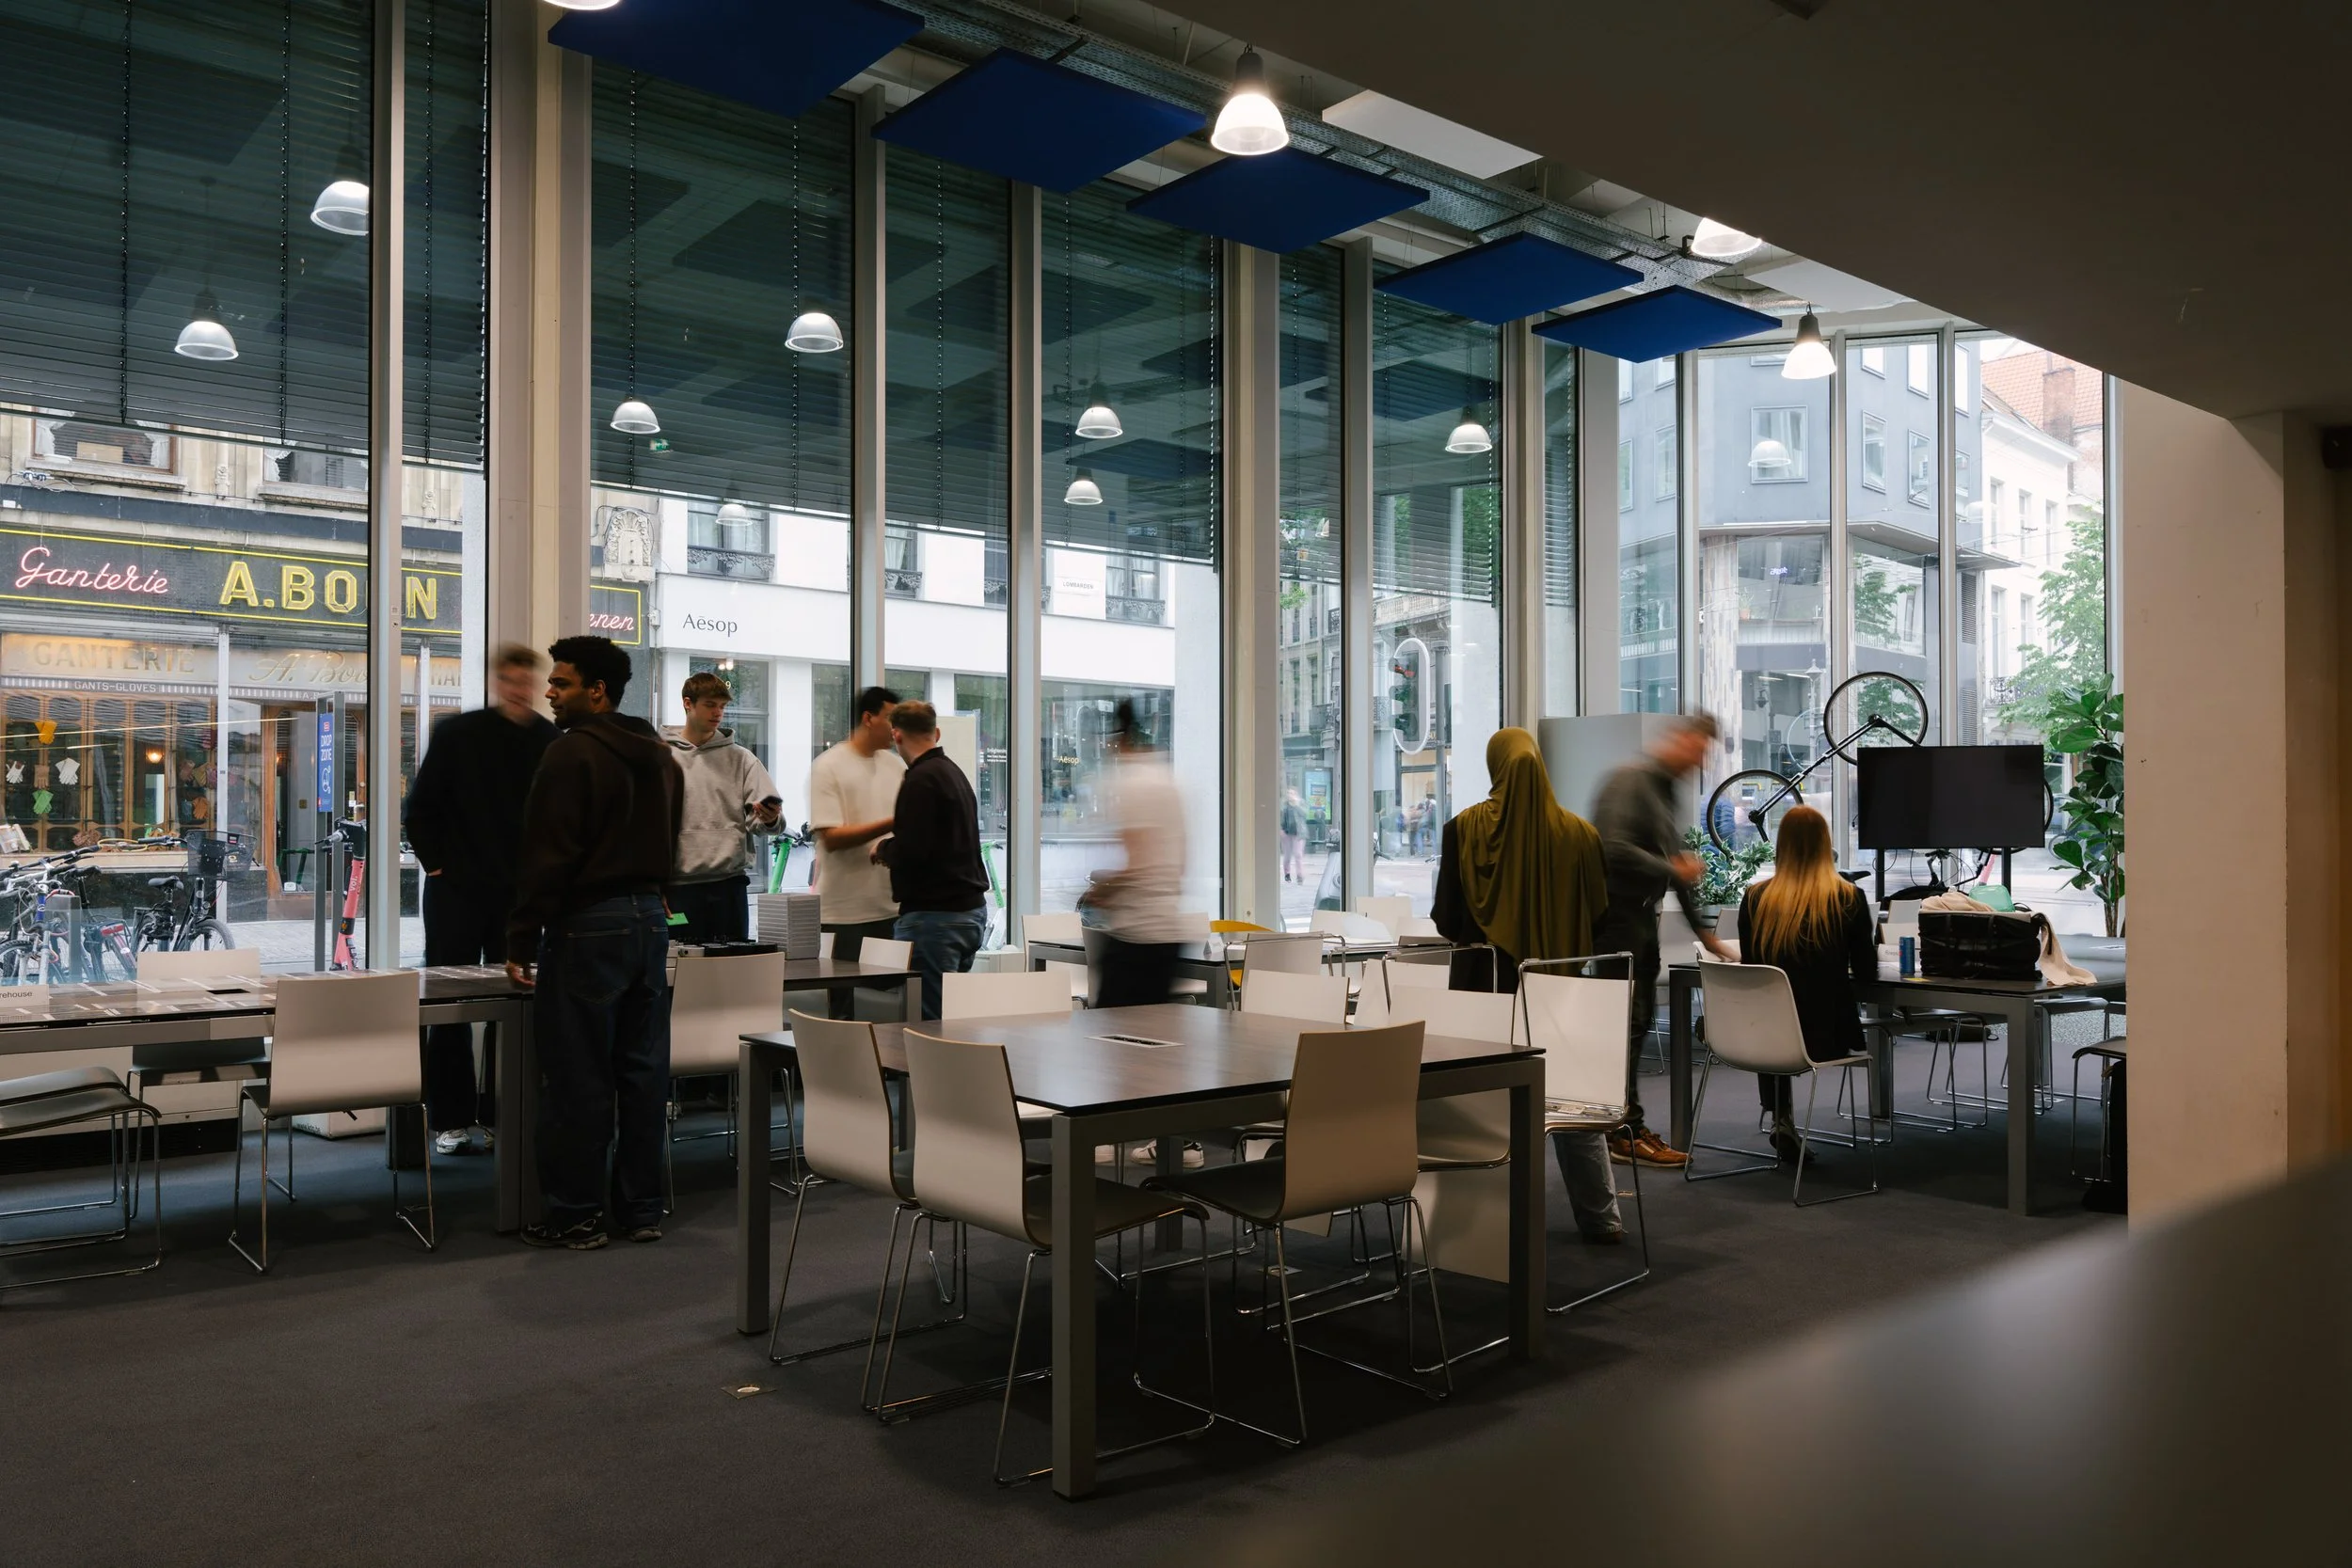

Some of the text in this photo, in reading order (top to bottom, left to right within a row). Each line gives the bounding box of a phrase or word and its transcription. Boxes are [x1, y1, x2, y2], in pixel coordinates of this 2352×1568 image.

[15, 546, 169, 594] Ganterie
[218, 561, 437, 621] A.BON
[33, 641, 196, 674] GANTERIE
[74, 680, 157, 693] GANTS-GLOVES
[725, 680, 732, 690] 9
[321, 735, 332, 747] DROP
[321, 749, 332, 761] ZONE
